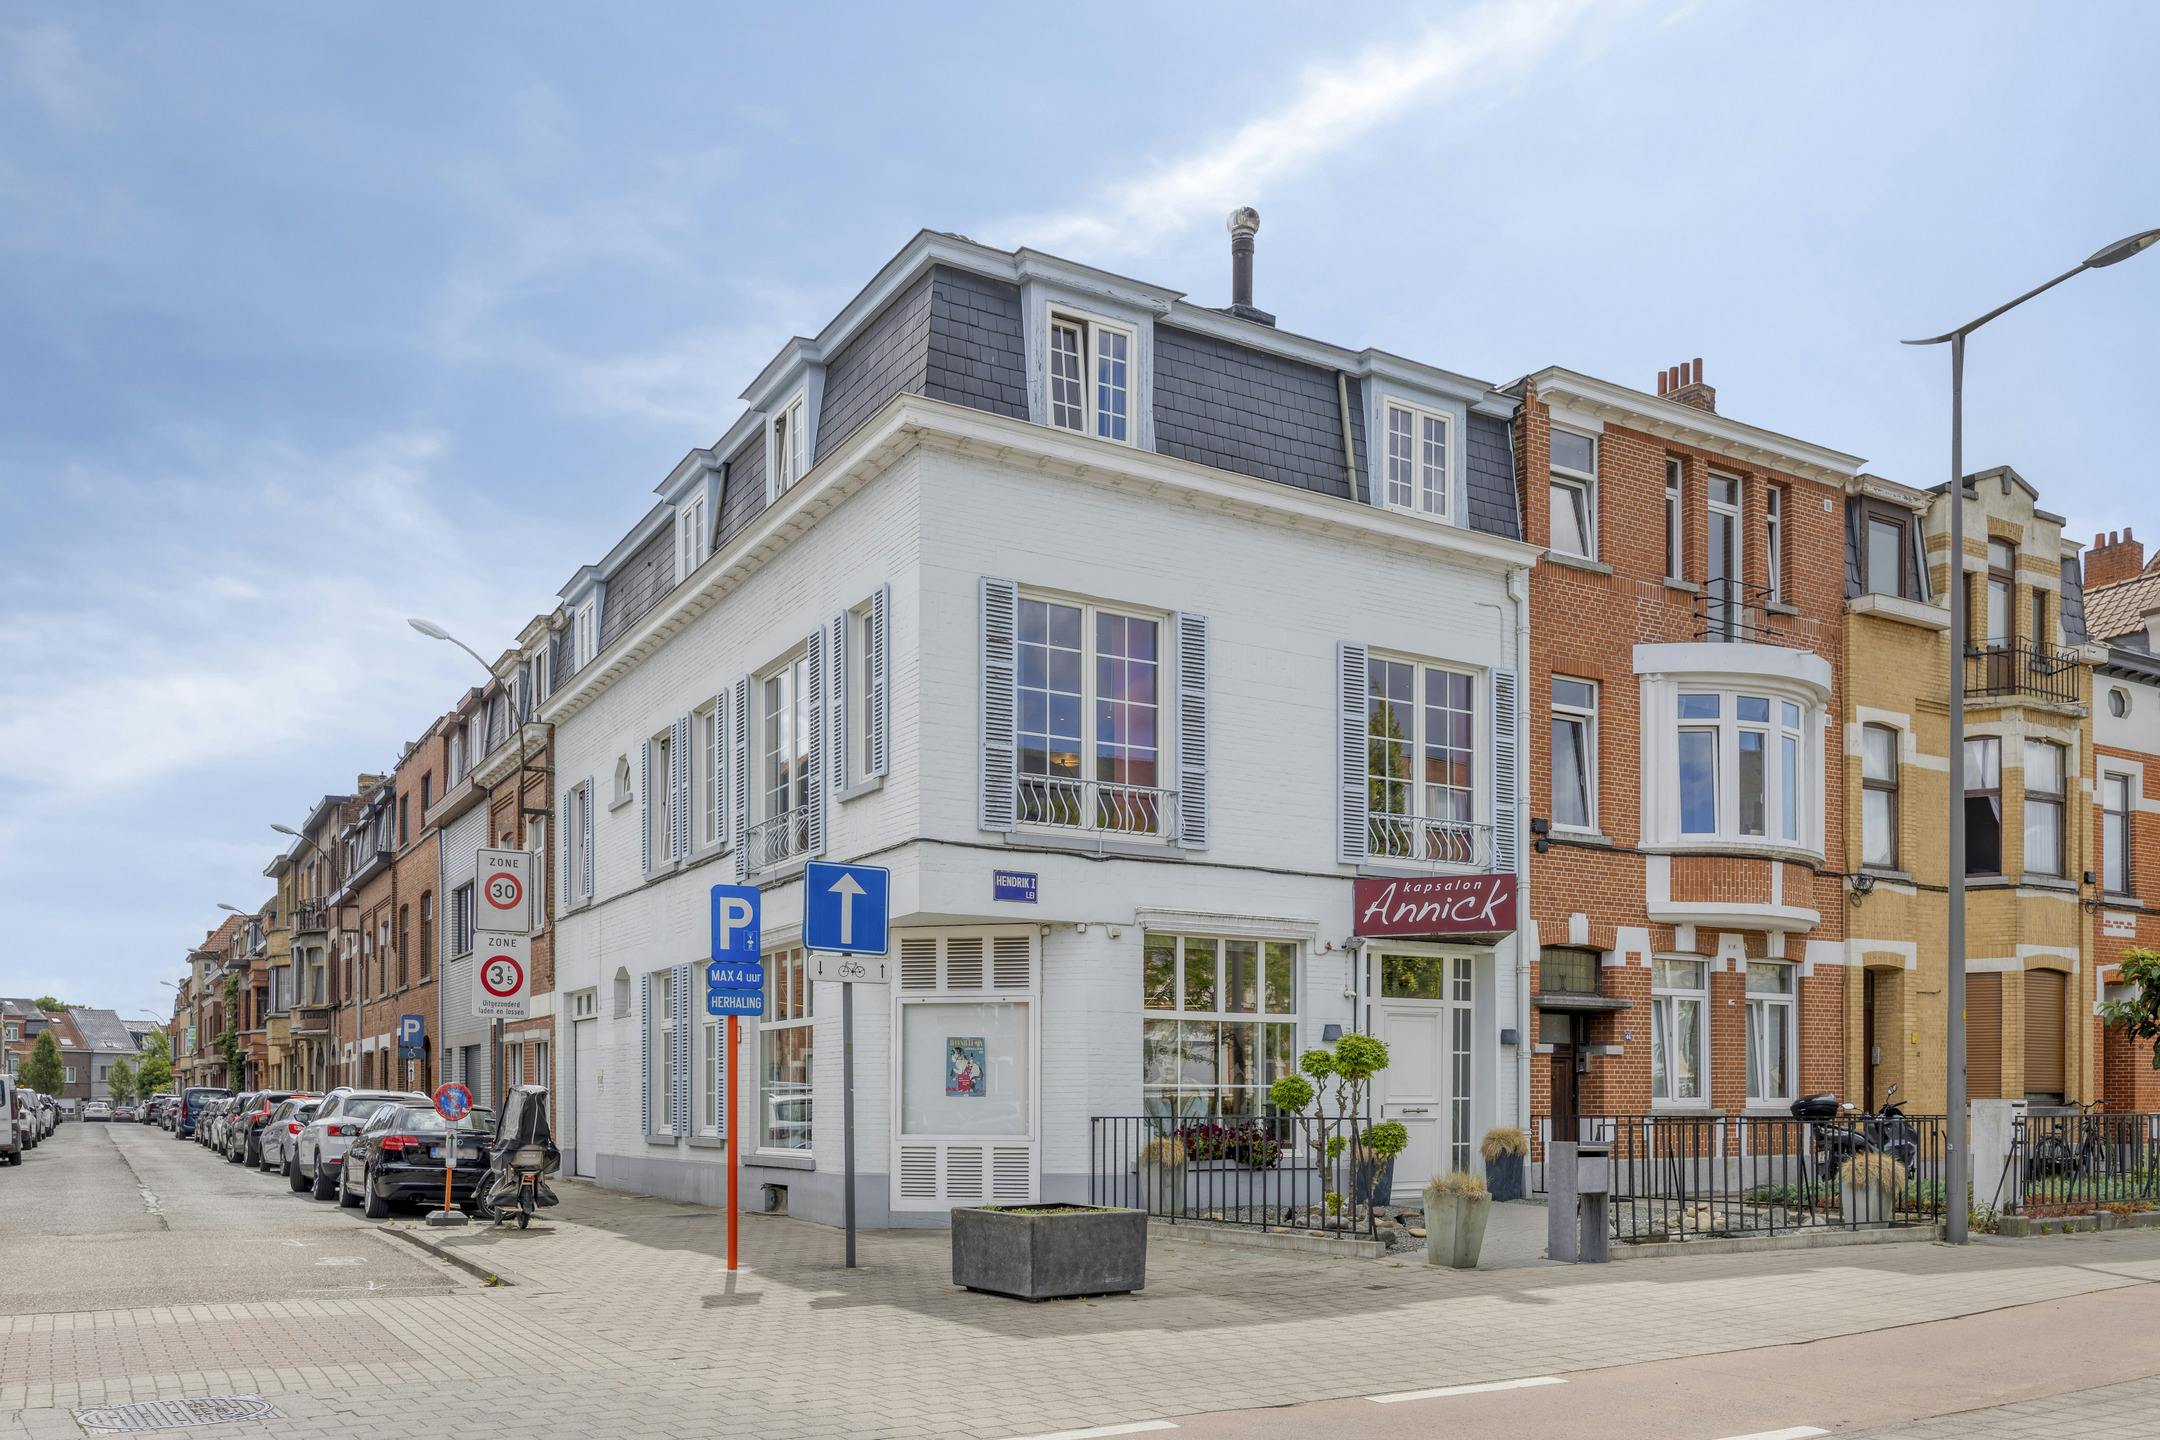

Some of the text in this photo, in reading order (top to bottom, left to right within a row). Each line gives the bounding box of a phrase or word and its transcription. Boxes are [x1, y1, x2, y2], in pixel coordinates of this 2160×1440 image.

[489, 857, 519, 868] ZONE
[996, 875, 1036, 889] HENDRIK I
[1403, 879, 1482, 894] kapsalon
[492, 883, 515, 899] 30
[1026, 891, 1035, 899] LEI
[720, 897, 753, 950] P
[488, 937, 517, 947] ZONE
[711, 970, 761, 982] MAX 4 uur
[482, 1000, 521, 1008] Uitgezonderd
[711, 996, 761, 1008] HERHALING
[505, 1008, 524, 1016] lossen
[404, 1020, 420, 1042] P
